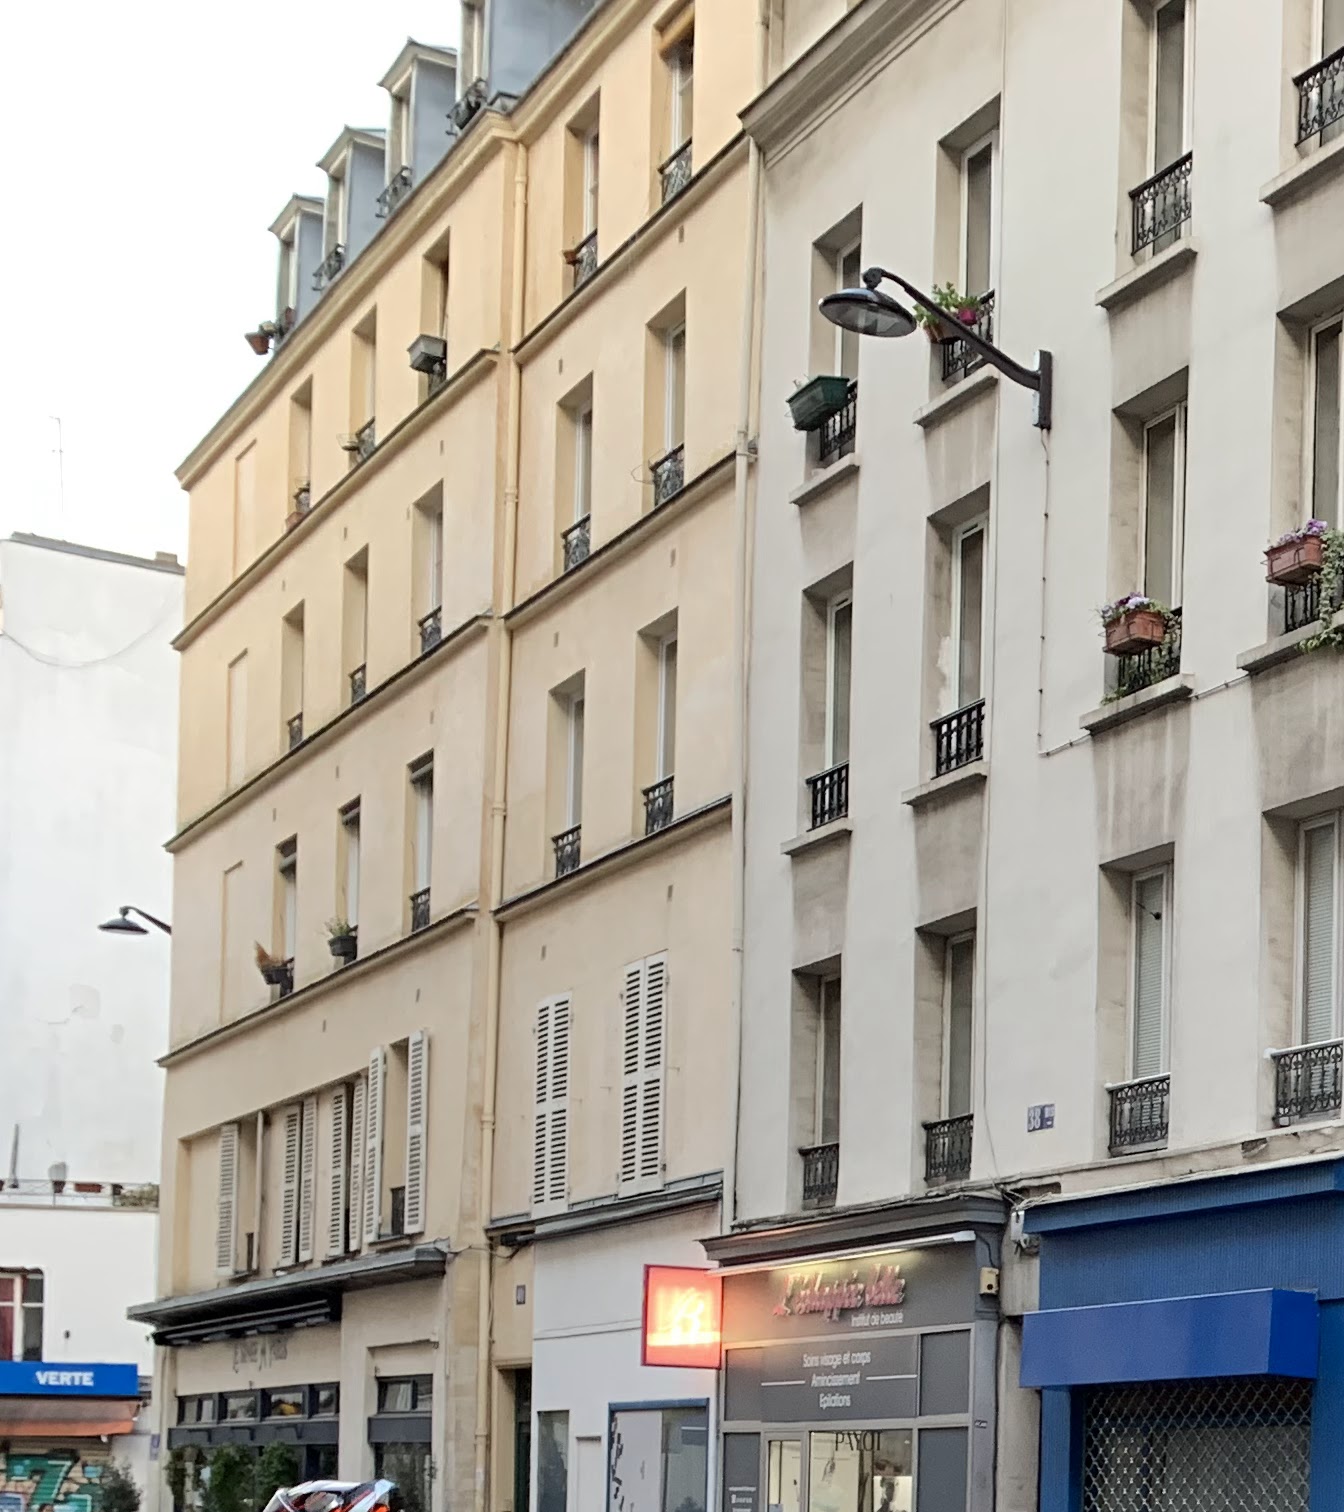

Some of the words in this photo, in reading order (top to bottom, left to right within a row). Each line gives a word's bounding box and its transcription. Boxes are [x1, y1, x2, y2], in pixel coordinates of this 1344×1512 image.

[1028, 1106, 1041, 1130] 38
[870, 1312, 880, 1326] de
[881, 1309, 904, 1325] beauté
[803, 1353, 819, 1368] Soins
[843, 1351, 850, 1365] et
[851, 1351, 871, 1366] corps
[35, 1371, 94, 1387] VERTE
[835, 1430, 881, 1451] PAYOT
